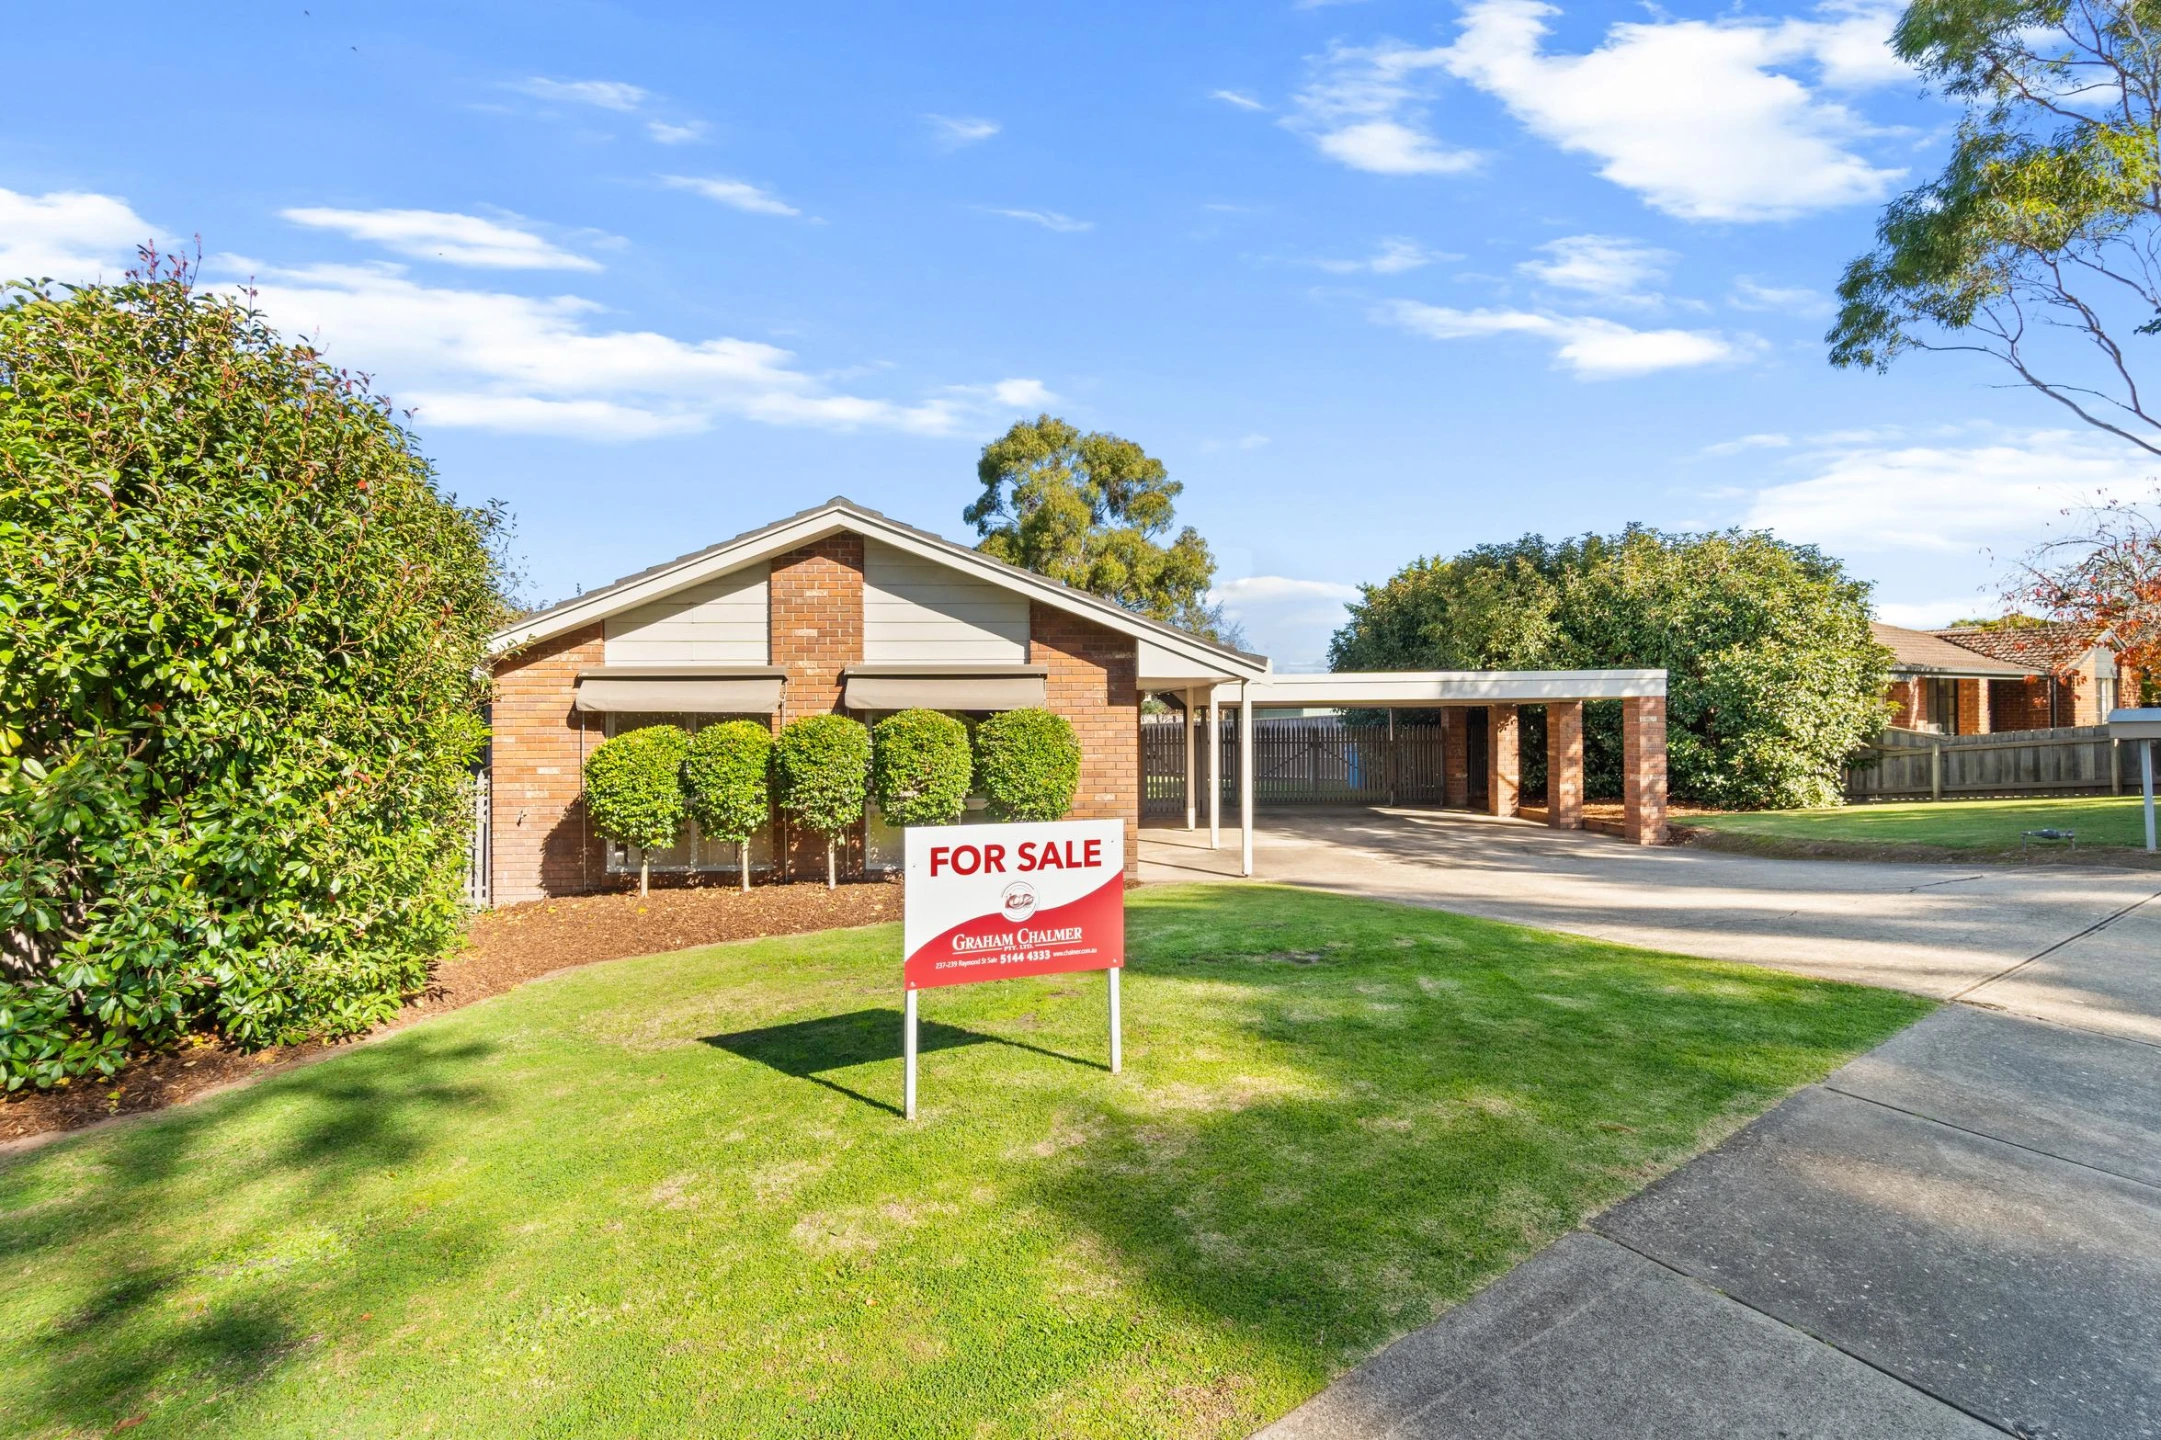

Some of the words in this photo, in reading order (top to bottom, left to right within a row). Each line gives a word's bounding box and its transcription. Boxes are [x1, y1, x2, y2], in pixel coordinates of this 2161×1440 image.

[930, 844, 1006, 877] FOR
[1017, 839, 1102, 872] SALE
[952, 933, 1014, 951] GRAHAM
[1017, 927, 1083, 945] CHALMER
[935, 961, 958, 970] 237-239
[958, 958, 981, 968] Raymond
[981, 956, 987, 964] St
[1000, 952, 1025, 964] 5144
[1026, 949, 1051, 961] 4333
[1052, 947, 1098, 957] www.chalmer.com.au
